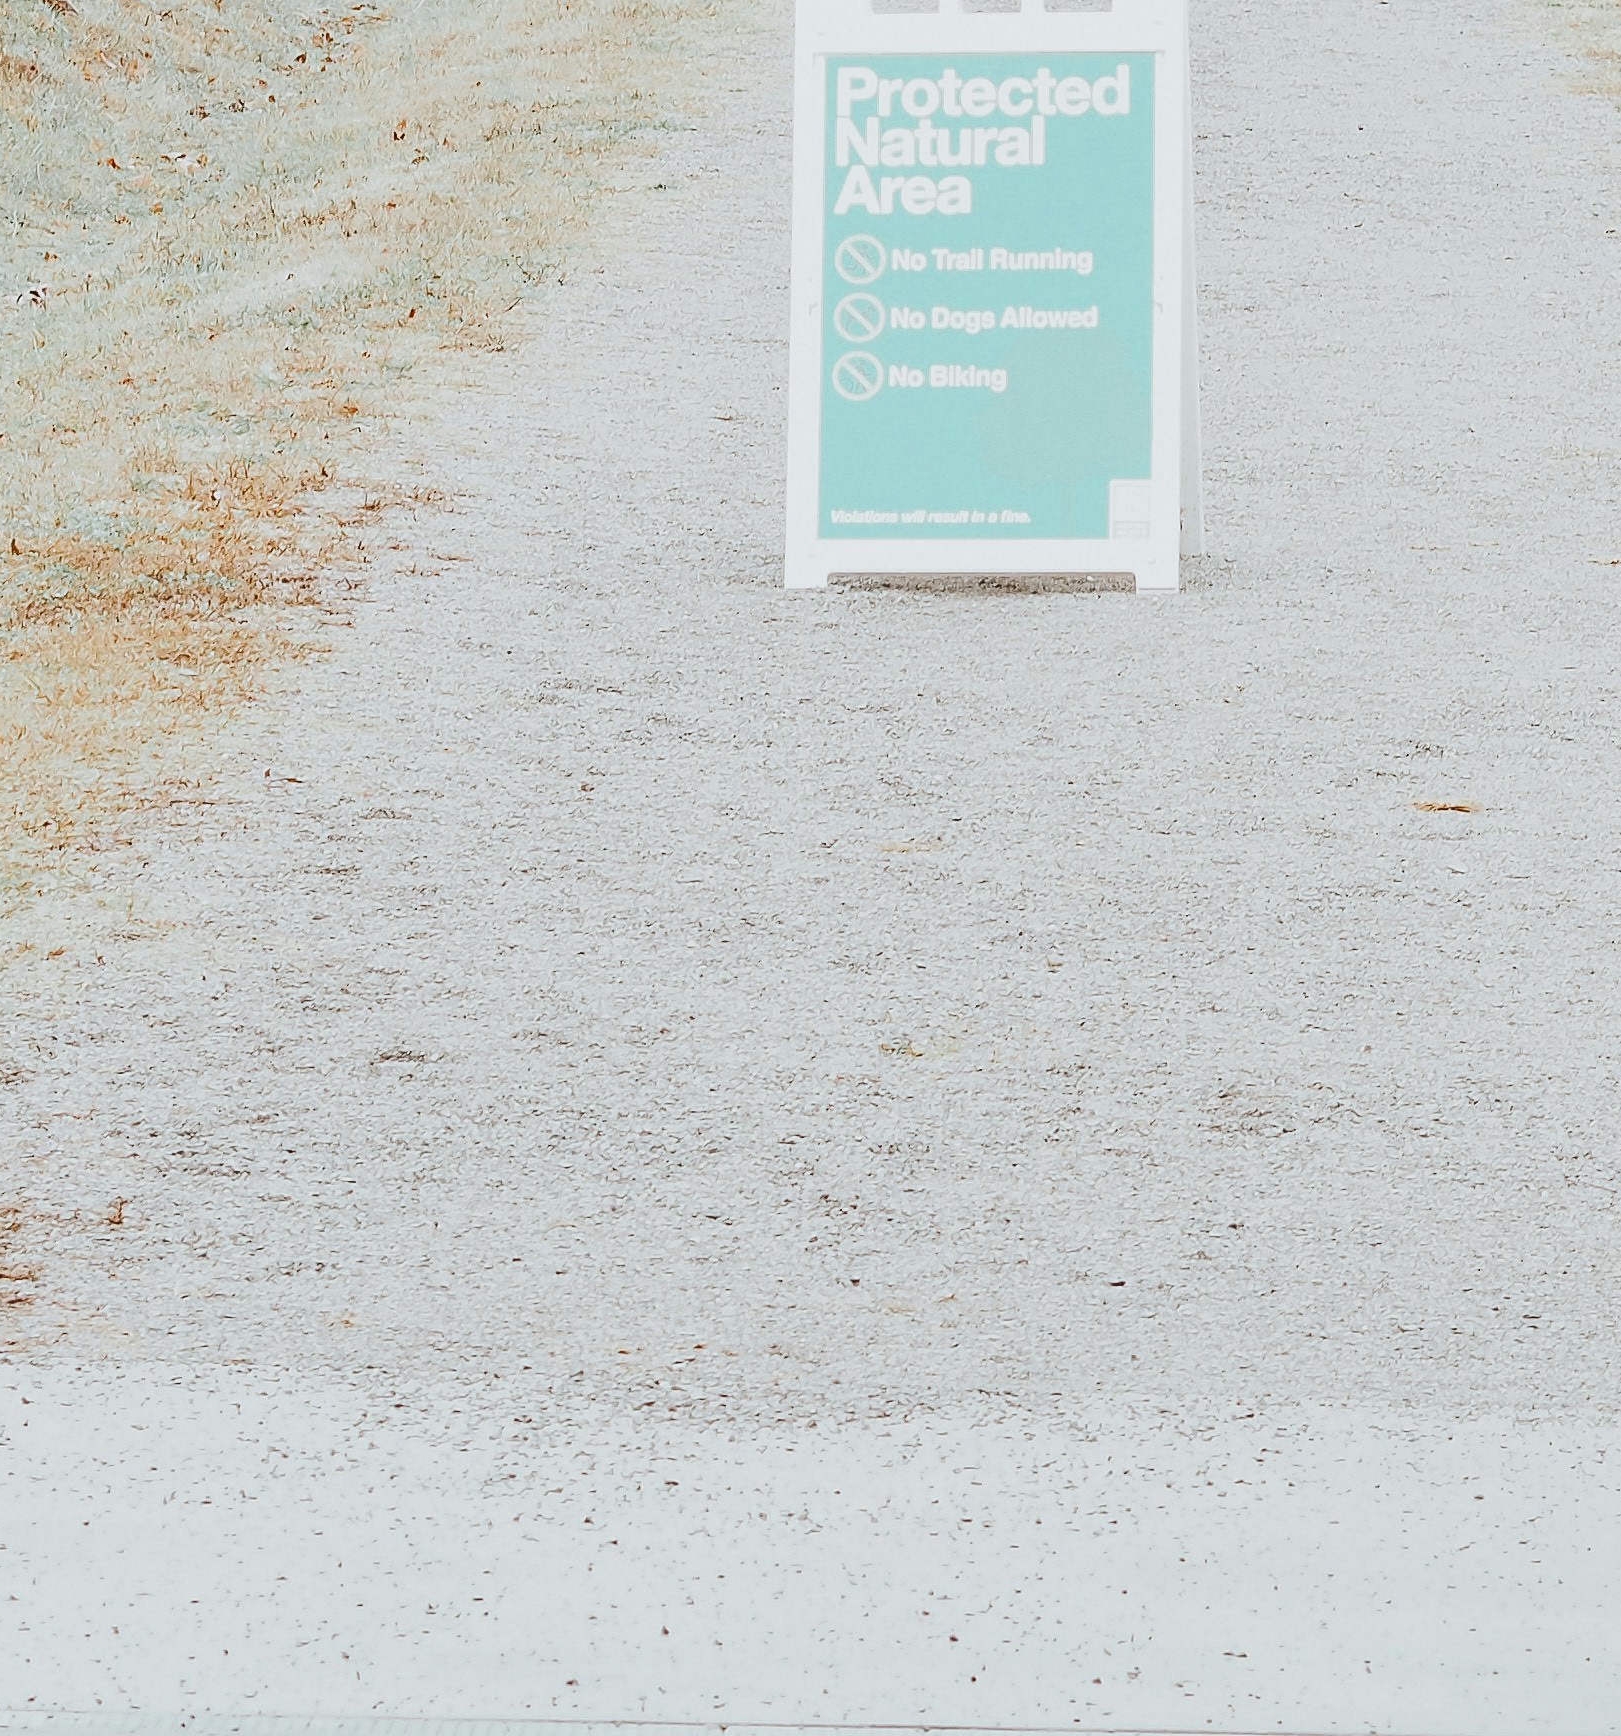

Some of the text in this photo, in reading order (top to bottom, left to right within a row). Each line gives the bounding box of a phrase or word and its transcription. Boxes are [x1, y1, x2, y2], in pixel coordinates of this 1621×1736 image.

[836, 64, 1131, 117] Protected
[835, 116, 1046, 166] Natural
[833, 165, 972, 215] Area
[891, 248, 1093, 274] No Trail Running
[890, 306, 1098, 334] No Dogs Allowed
[888, 365, 1007, 392] No Biking
[830, 509, 1032, 524] Violations will result in a fine.
